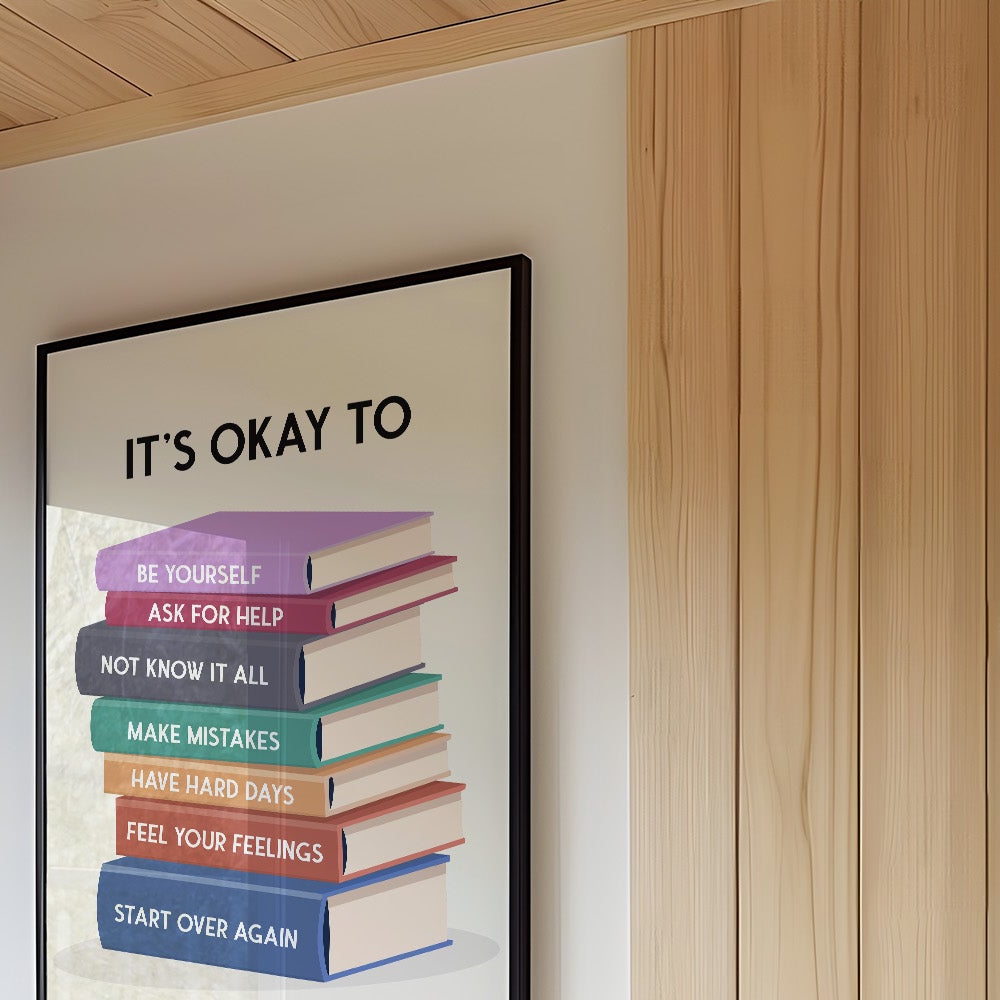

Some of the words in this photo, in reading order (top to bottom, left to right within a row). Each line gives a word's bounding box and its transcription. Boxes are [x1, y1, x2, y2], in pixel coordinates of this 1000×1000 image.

[125, 429, 196, 479] IT'S
[211, 405, 331, 464] OKAY
[347, 395, 412, 444] TO
[137, 564, 159, 583] BE
[165, 564, 262, 584] YOURSELF
[148, 603, 184, 622] ASK
[191, 604, 230, 624] FOR
[236, 606, 284, 626] HELP
[101, 655, 140, 675] NOT
[146, 658, 204, 680] KNOW
[210, 662, 227, 682] IT
[233, 665, 268, 685] ALL
[127, 721, 181, 744] MAKE
[187, 725, 280, 750] MISTAKES
[131, 769, 180, 792] HAVE
[185, 775, 238, 798] HARD
[245, 782, 294, 805] DAYS
[126, 821, 167, 844] FEEL
[174, 827, 226, 852] YOUR
[232, 834, 323, 863] FEELINGS
[114, 903, 171, 929] START
[177, 913, 228, 939] OVER
[234, 922, 298, 949] AGAIN
